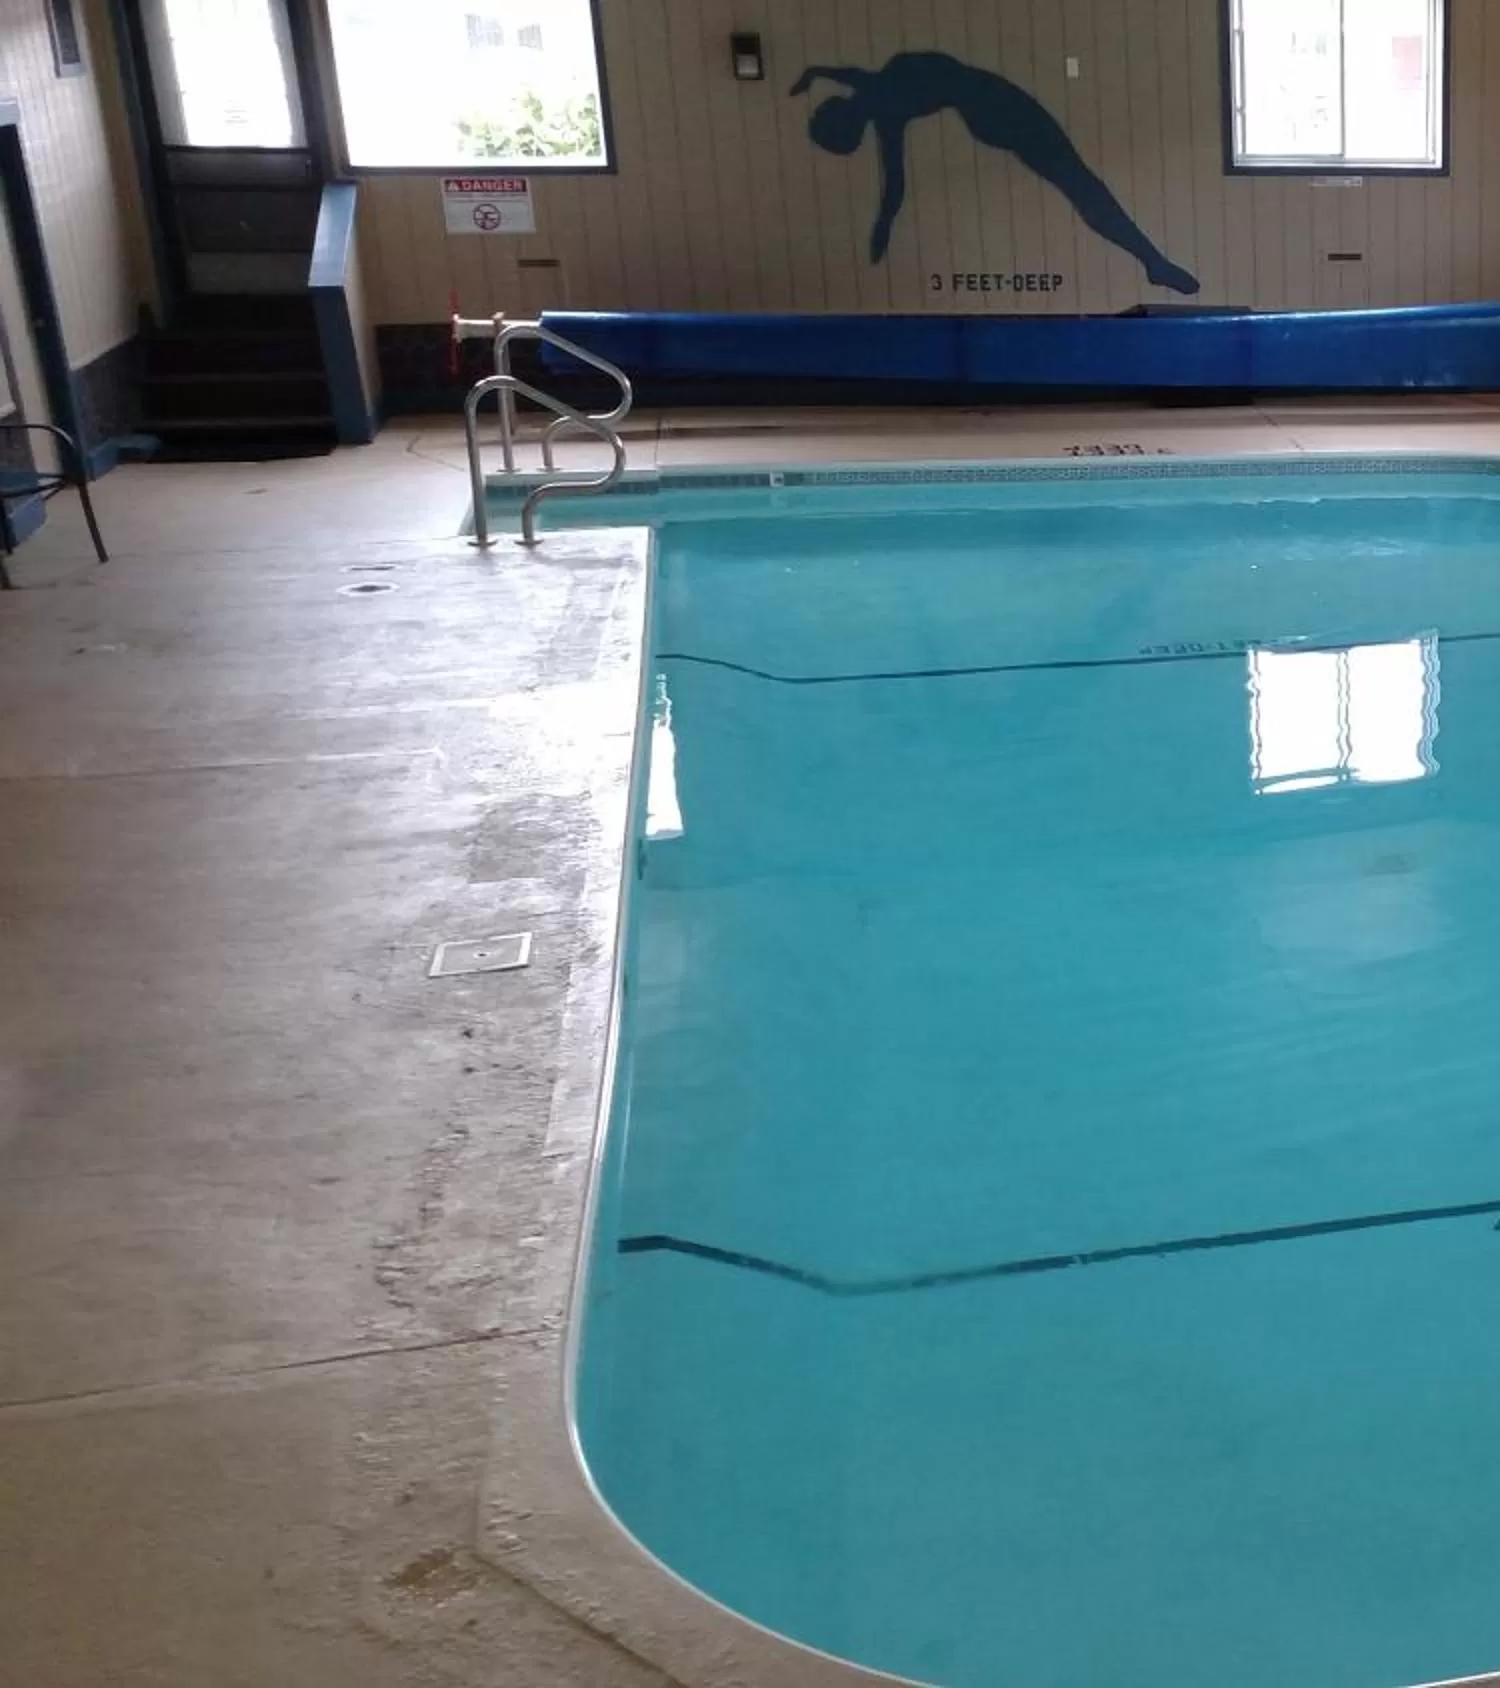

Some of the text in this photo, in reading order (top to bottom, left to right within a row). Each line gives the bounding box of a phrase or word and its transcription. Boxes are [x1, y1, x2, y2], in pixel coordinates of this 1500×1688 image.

[461, 179, 523, 191] DANGER
[931, 273, 1063, 292] 3 FEET-DEEP
